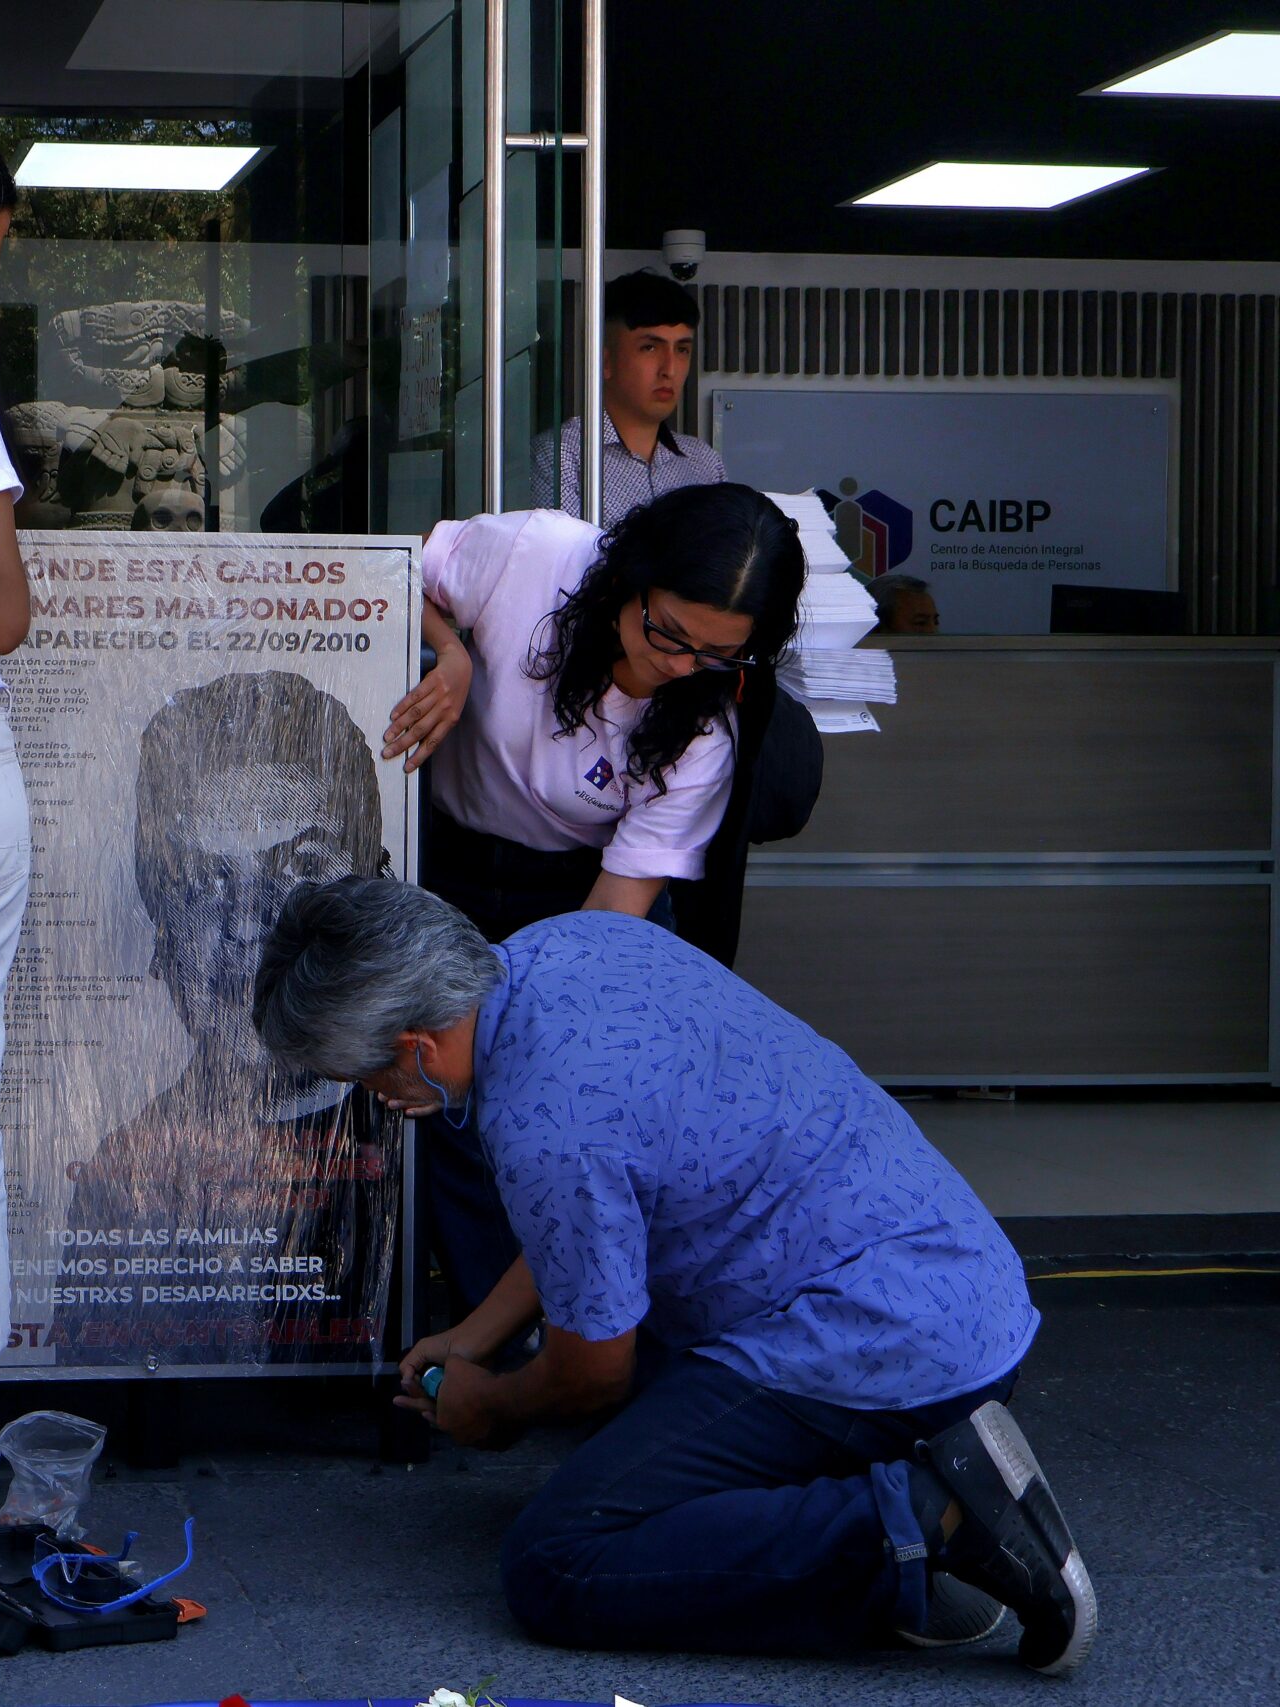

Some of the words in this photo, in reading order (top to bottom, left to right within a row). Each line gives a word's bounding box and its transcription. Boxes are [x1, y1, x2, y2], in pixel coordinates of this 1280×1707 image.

[929, 499, 1051, 533] CAIBP
[930, 543, 968, 555] Centro
[971, 543, 985, 555] de
[988, 542, 1038, 555] Atención
[1041, 543, 1084, 558] Integral
[22, 552, 117, 581] ÓNDE
[126, 553, 206, 583] ESTÁ
[216, 559, 346, 585] CARLOS
[930, 562, 955, 572] para
[959, 559, 968, 570] la
[972, 559, 1027, 572] Búsqueda
[1031, 559, 1045, 570] de
[1048, 559, 1101, 570] Personas
[30, 595, 145, 619] MARES
[155, 597, 389, 622] MALDONADO?
[20, 629, 179, 651] APARECIDO
[187, 631, 220, 651] EL
[226, 629, 371, 654] 22/09/2010
[37, 687, 60, 696] que
[38, 695, 61, 705] hijo
[34, 706, 56, 715] que
[24, 740, 71, 751] destino,
[22, 750, 60, 760] donde
[19, 984, 50, 992] crece
[14, 993, 42, 1001] alma
[46, 1228, 122, 1246] TODAS
[129, 1229, 170, 1245] LAS
[176, 1227, 278, 1245] FAMILIAS
[114, 1256, 221, 1275] DERECHO
[228, 1258, 244, 1273] A
[250, 1256, 323, 1273] SABER
[16, 1286, 133, 1304] NUESTRXS
[142, 1284, 341, 1303] DESAPARECIDXS...
